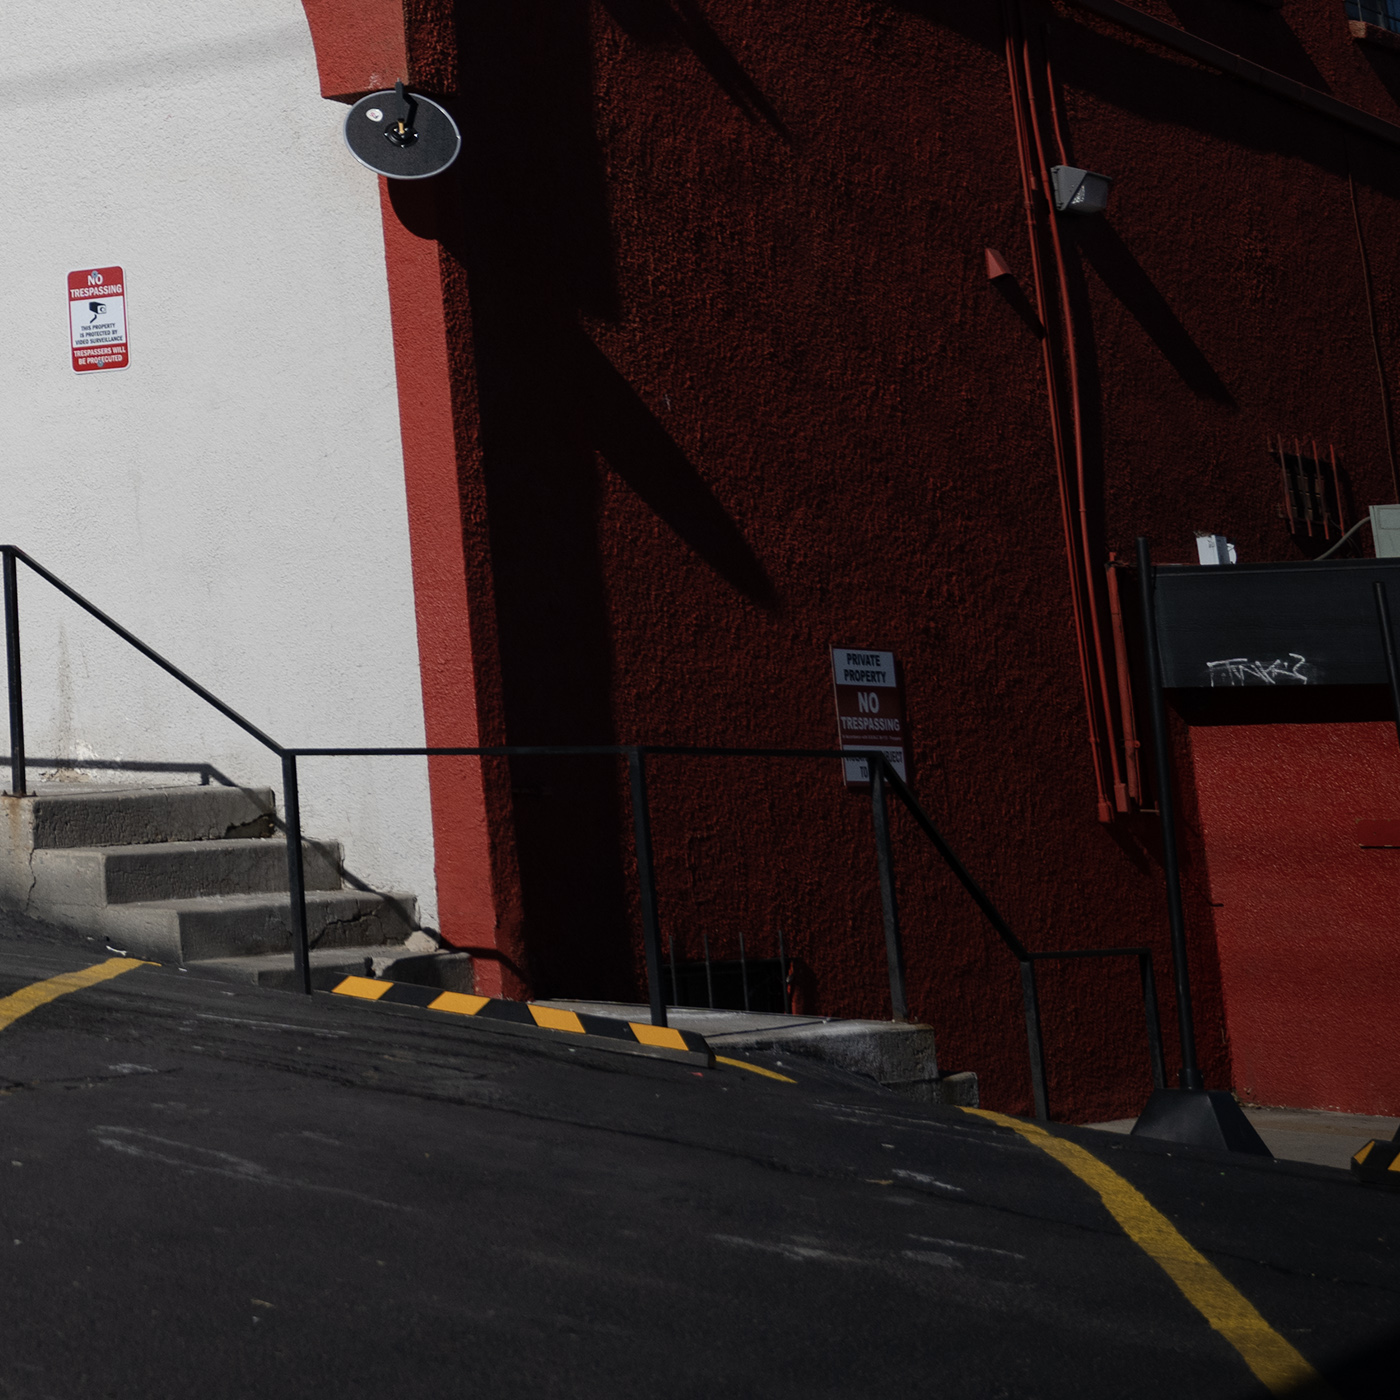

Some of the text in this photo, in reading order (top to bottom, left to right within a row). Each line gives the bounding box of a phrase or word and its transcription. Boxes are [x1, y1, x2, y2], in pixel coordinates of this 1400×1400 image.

[87, 273, 104, 286] NO
[70, 284, 123, 298] TRESPASSING
[86, 330, 111, 338] PROTECTED
[90, 335, 123, 344] SURVEILLANCE
[74, 348, 112, 357] TRESPASSERS
[846, 653, 881, 667] PRIVATE
[843, 669, 886, 683] PROPERTY
[857, 691, 880, 713] NO
[840, 716, 901, 731] TRESPASSING
